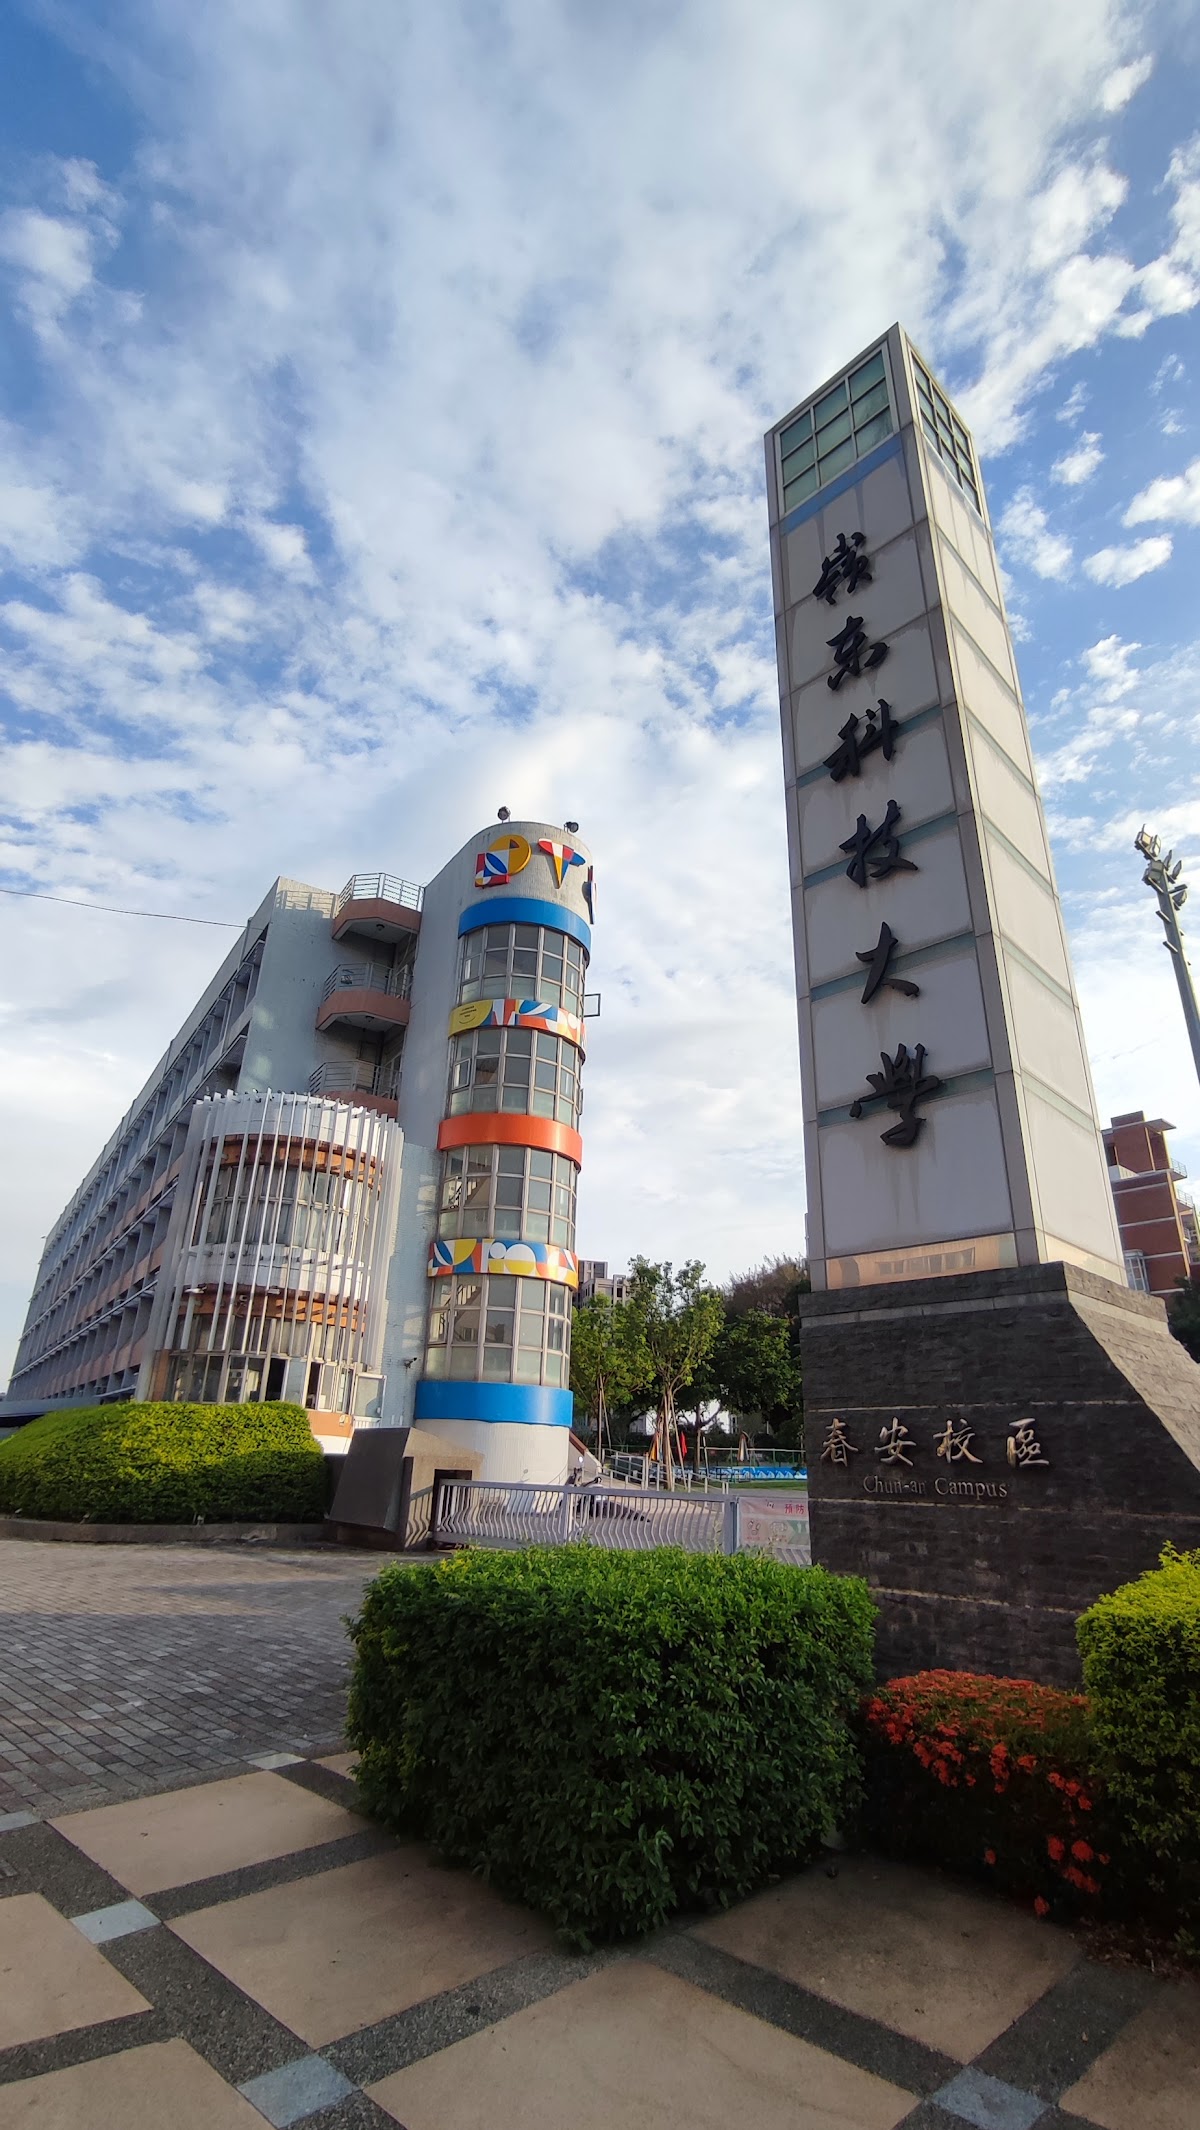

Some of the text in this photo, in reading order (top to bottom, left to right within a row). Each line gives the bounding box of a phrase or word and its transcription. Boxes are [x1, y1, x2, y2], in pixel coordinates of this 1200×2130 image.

[820, 1417, 1050, 1467] 春安校區
[863, 1475, 1008, 1500] Chun-an Campus
